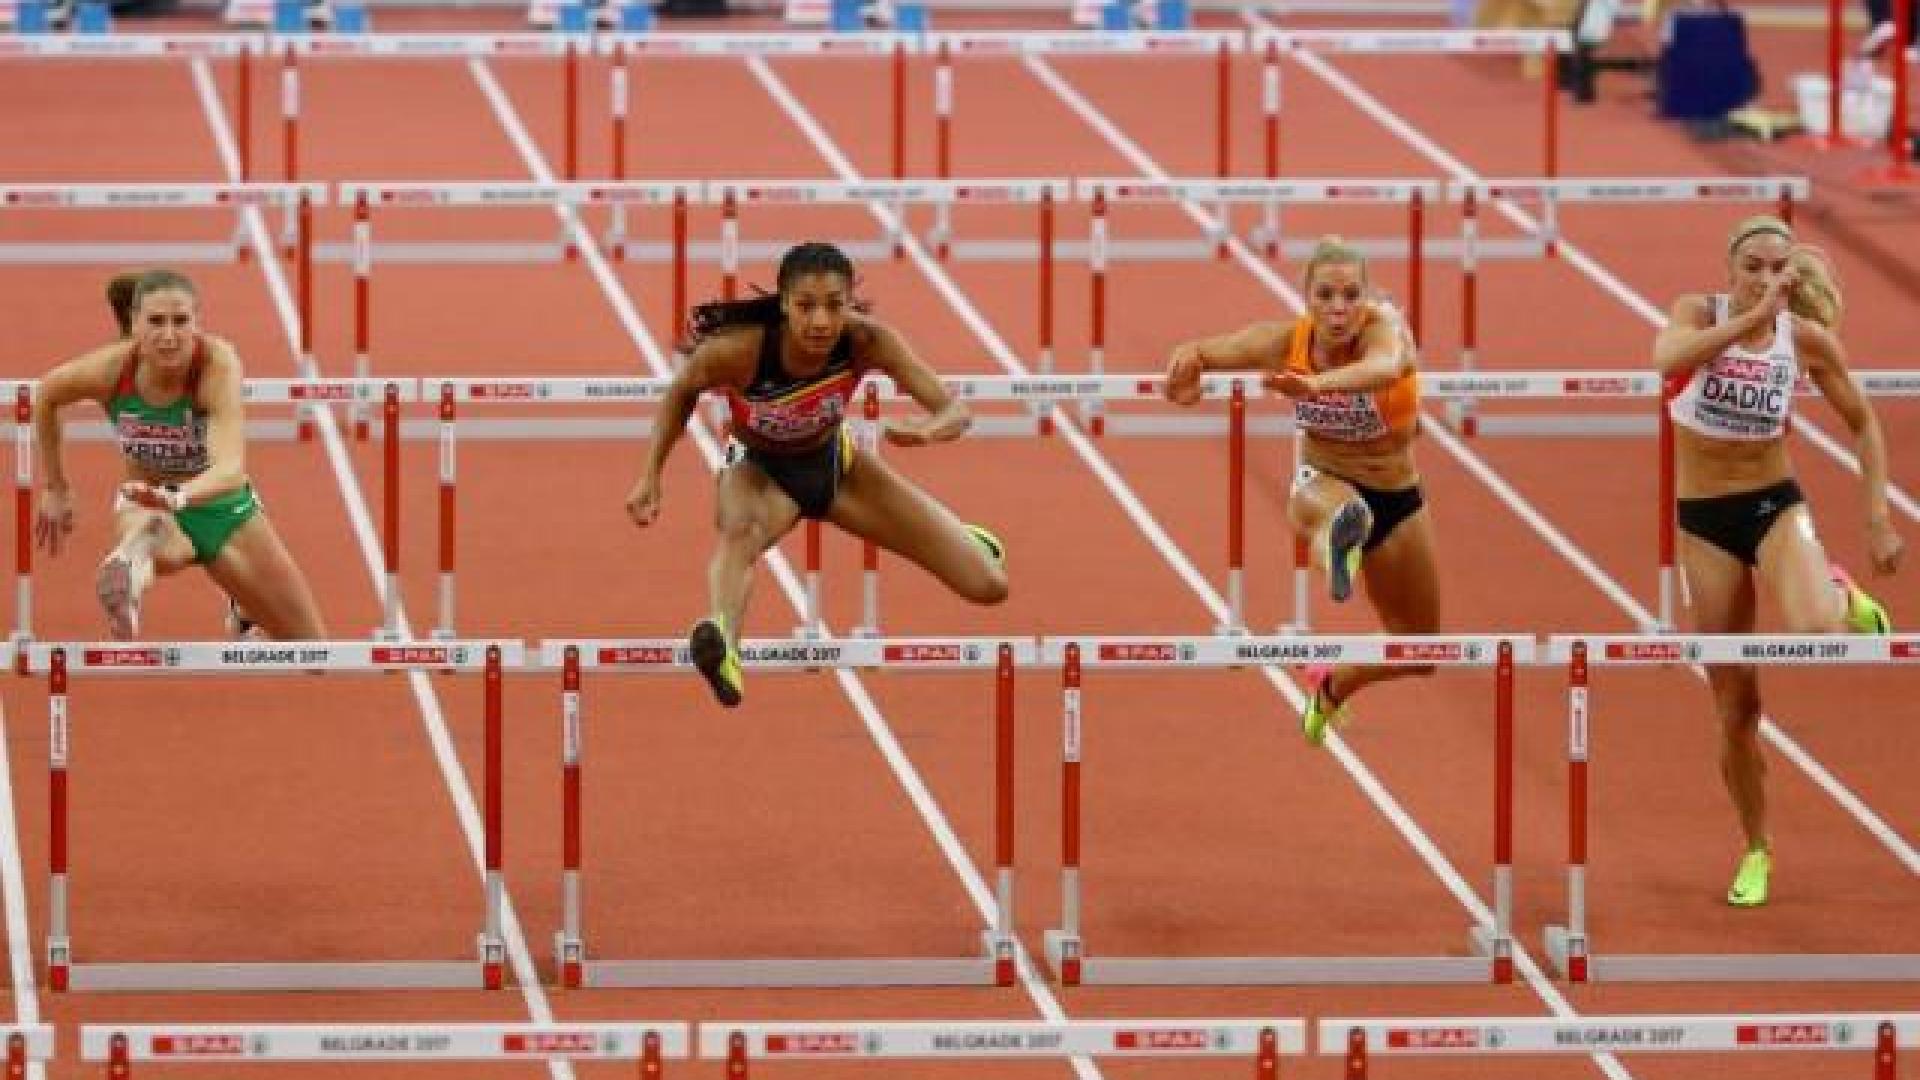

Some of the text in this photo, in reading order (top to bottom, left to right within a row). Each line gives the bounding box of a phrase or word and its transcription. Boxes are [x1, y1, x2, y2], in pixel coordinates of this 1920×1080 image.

[1703, 375, 1783, 413] DADIC
[221, 650, 295, 664] BELGRADE
[1234, 644, 1309, 658] BELGRADE
[1742, 644, 1815, 658] BELGRADE
[320, 1035, 409, 1051] BELGRADE
[933, 1032, 1021, 1049] BELGRADE
[1555, 1028, 1643, 1044] BELGRADE
